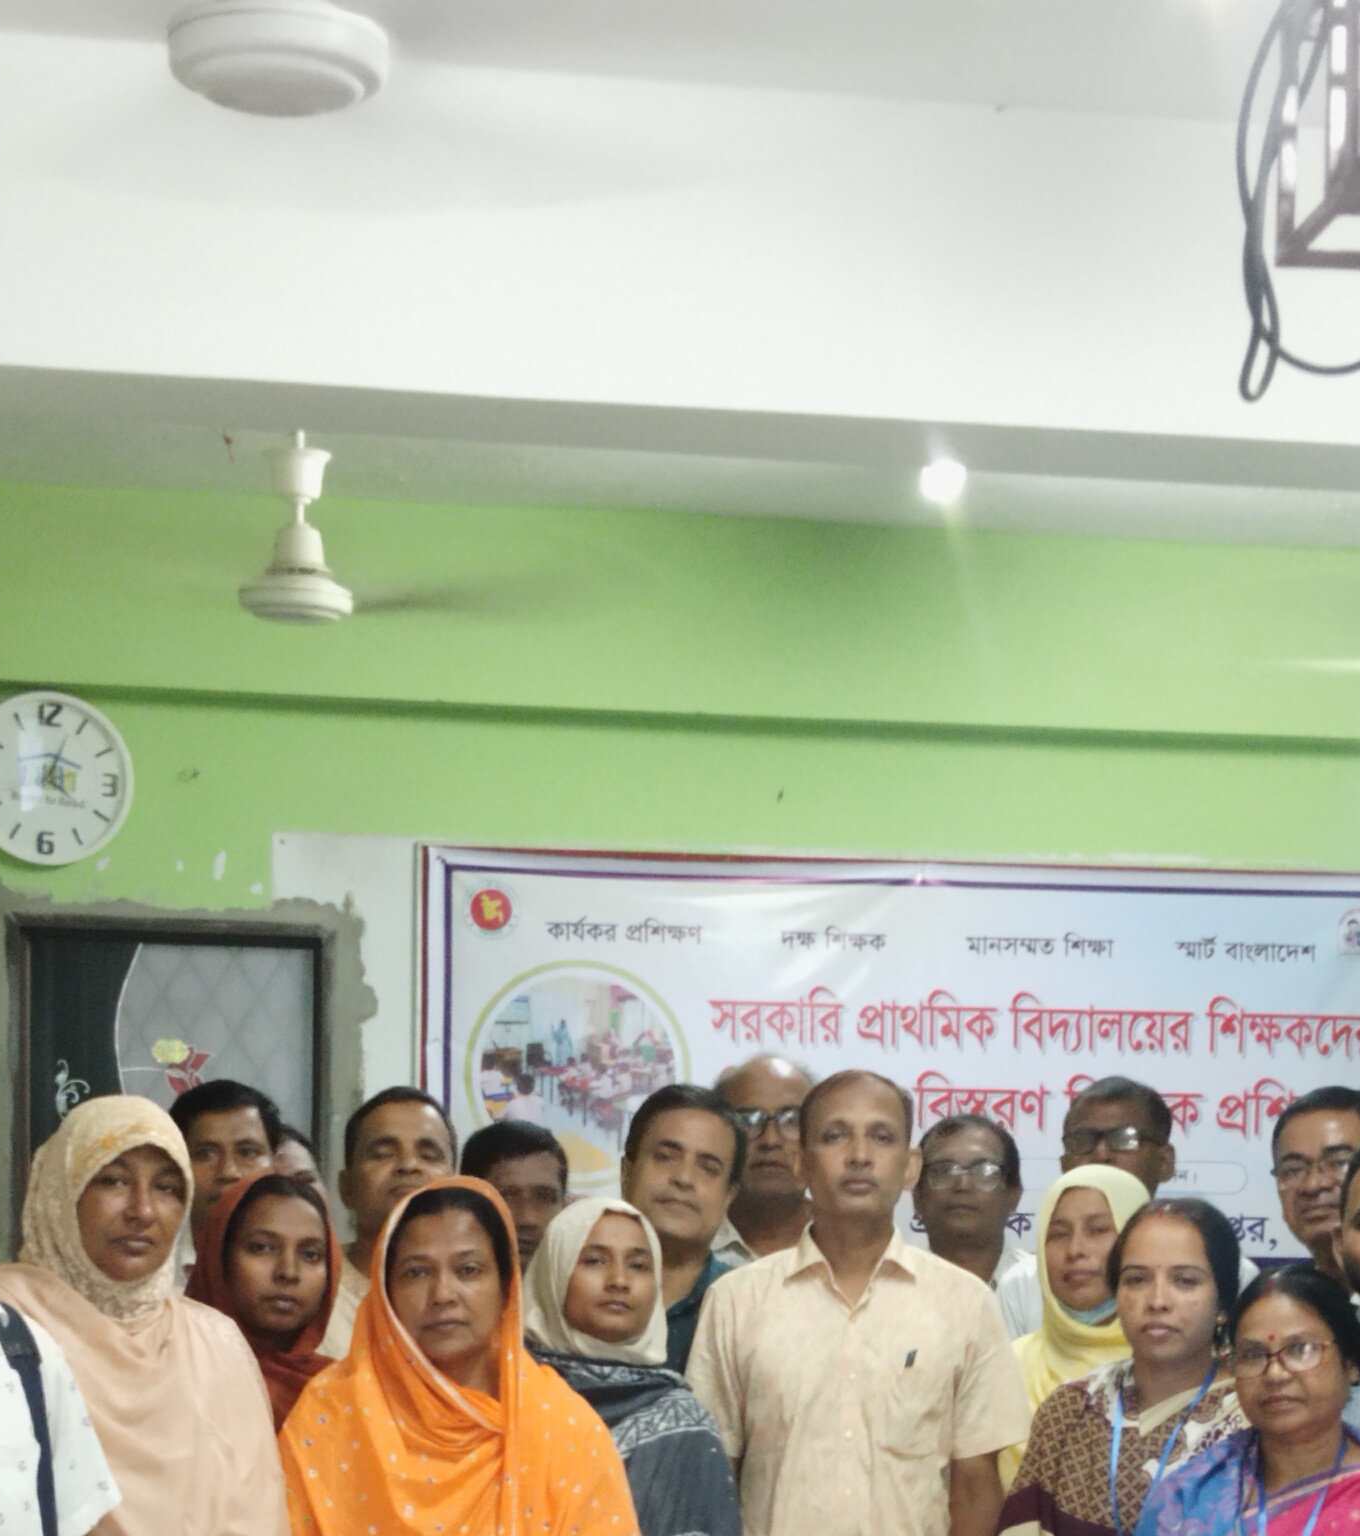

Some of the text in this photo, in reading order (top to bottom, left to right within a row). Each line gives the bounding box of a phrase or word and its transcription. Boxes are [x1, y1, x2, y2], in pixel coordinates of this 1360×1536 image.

[38, 701, 64, 728] 12
[101, 772, 119, 798] 3
[36, 831, 55, 856] 6
[546, 916, 702, 945] কার্যকর প্রশিক্ষণ
[781, 926, 887, 951] দক্ষ শিক্ষক
[965, 931, 1114, 959] মানসম্মত শিক্ষা
[1224, 940, 1317, 963] বাংলাদেশ
[708, 984, 844, 1046] সরকারি
[856, 989, 998, 1051] প্রাথমিক
[1008, 990, 1194, 1053] বিদ্যালয়ের
